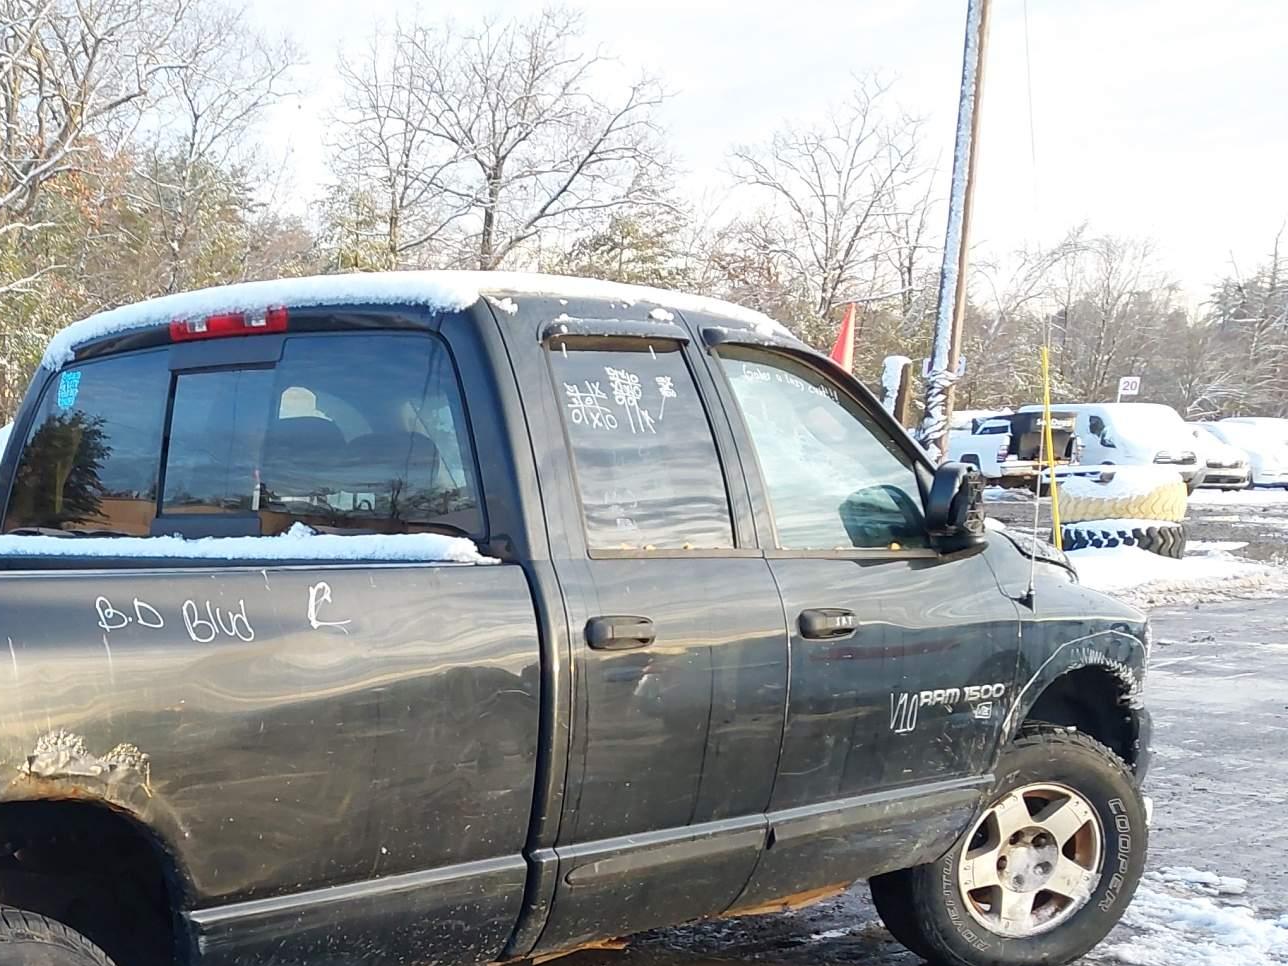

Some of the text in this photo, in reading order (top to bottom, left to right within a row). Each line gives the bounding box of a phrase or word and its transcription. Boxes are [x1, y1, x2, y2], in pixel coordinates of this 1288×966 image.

[1122, 380, 1138, 391] 20
[919, 682, 1006, 707] RAM 1500
[1097, 797, 1131, 913] COOPER
